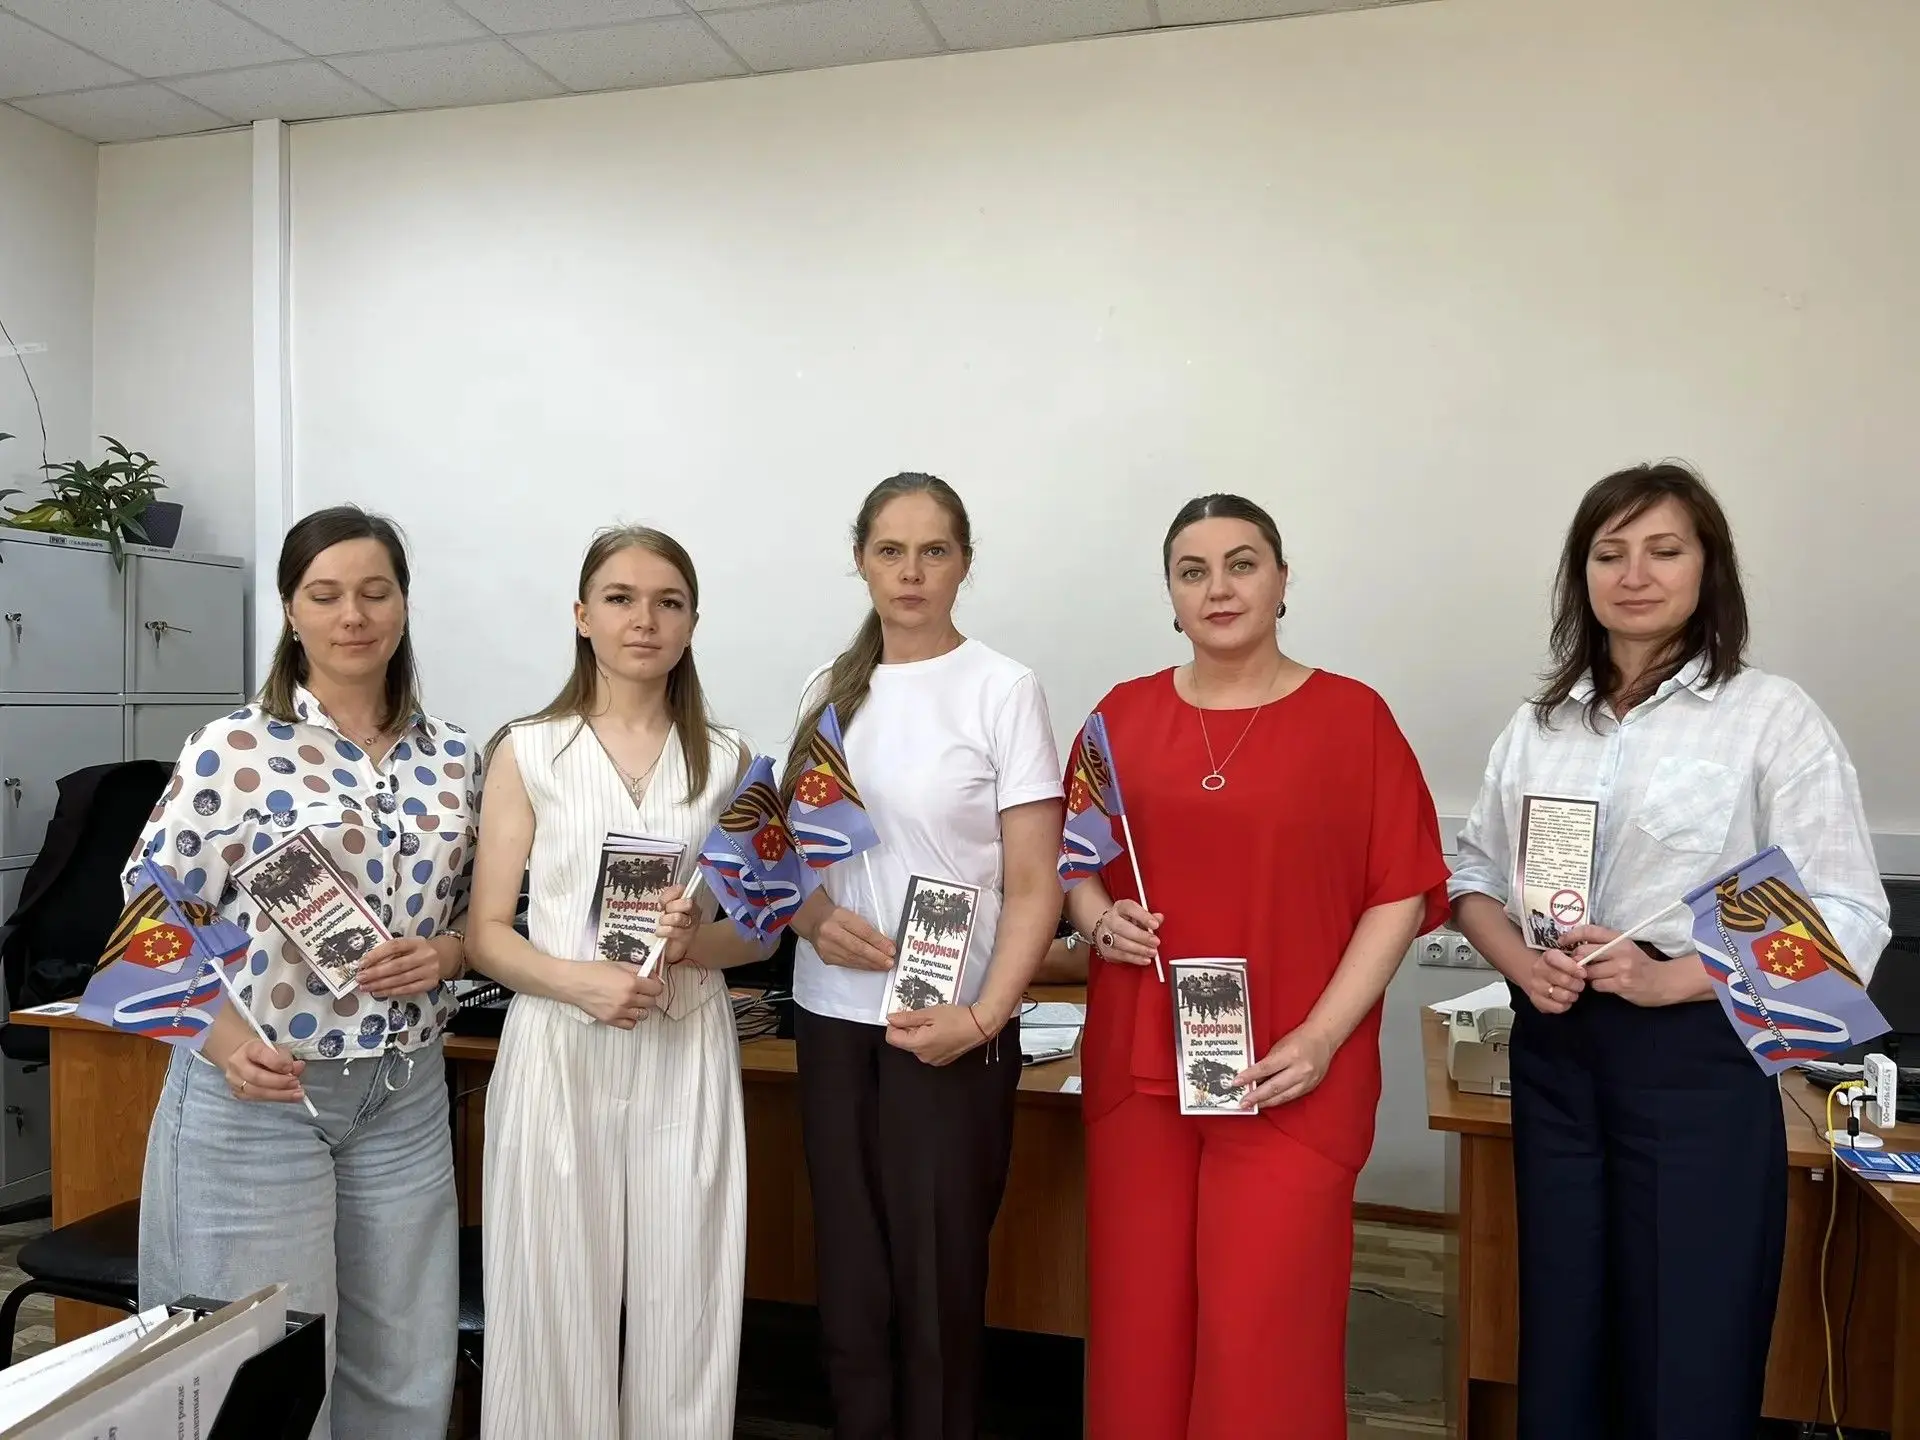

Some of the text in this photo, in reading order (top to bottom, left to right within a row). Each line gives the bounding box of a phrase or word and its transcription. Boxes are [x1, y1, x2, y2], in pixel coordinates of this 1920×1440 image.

[281, 886, 341, 931] Терроризм
[299, 902, 345, 938] Его причины
[312, 907, 356, 941] последствия
[623, 914, 656, 924] причины
[612, 922, 657, 934] последстви
[907, 935, 960, 960] Терроризм
[907, 954, 952, 971] Его причины
[909, 966, 954, 982] последствия
[1732, 953, 1750, 982] ОКРУГ
[1745, 980, 1768, 1017] ПРОТИВ
[1764, 1014, 1793, 1053] ТЕРРОРА
[1184, 1021, 1242, 1039] Терроризм
[1190, 1039, 1238, 1048] Его причины
[1195, 1048, 1244, 1057] последствия
